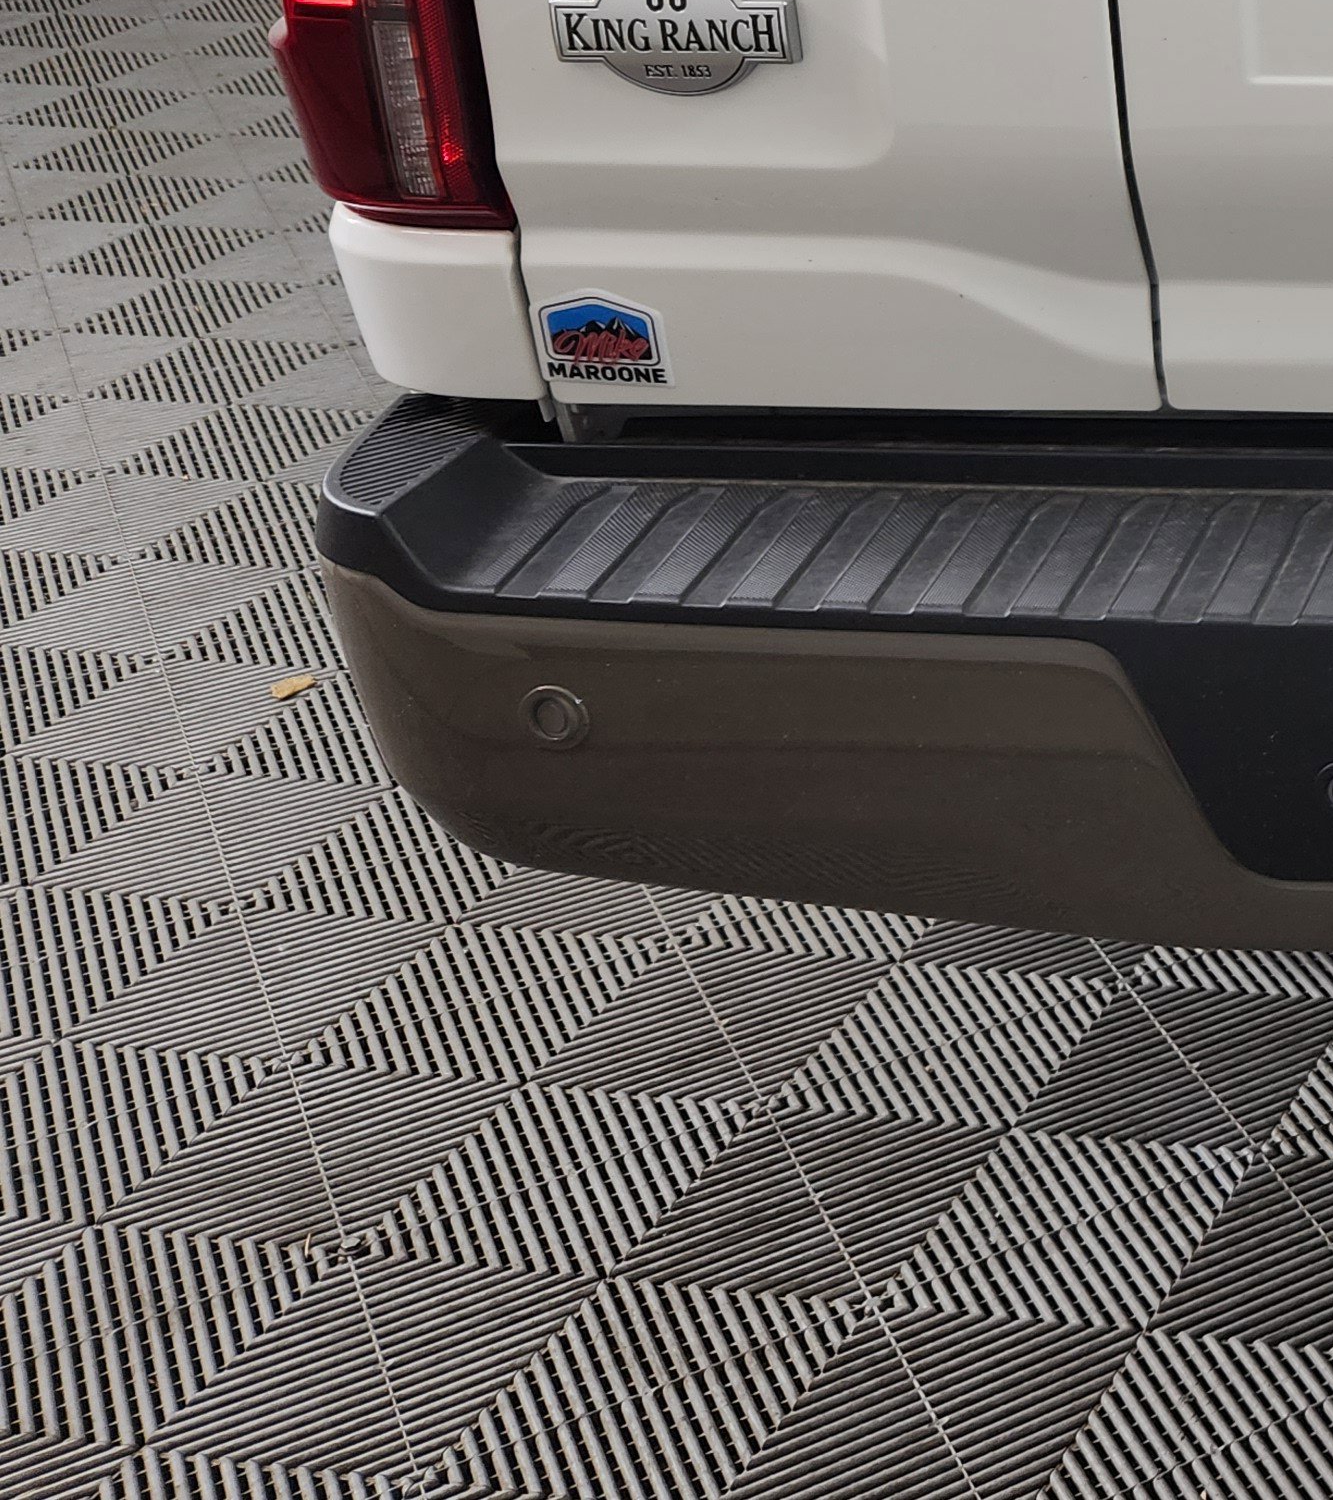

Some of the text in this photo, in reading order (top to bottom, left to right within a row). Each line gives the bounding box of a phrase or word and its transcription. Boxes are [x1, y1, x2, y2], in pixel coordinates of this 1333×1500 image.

[563, 13, 778, 53] KING RANCH
[644, 65, 712, 78] EST. 1853
[555, 329, 649, 363] Mike
[548, 362, 668, 384] MAROONE
